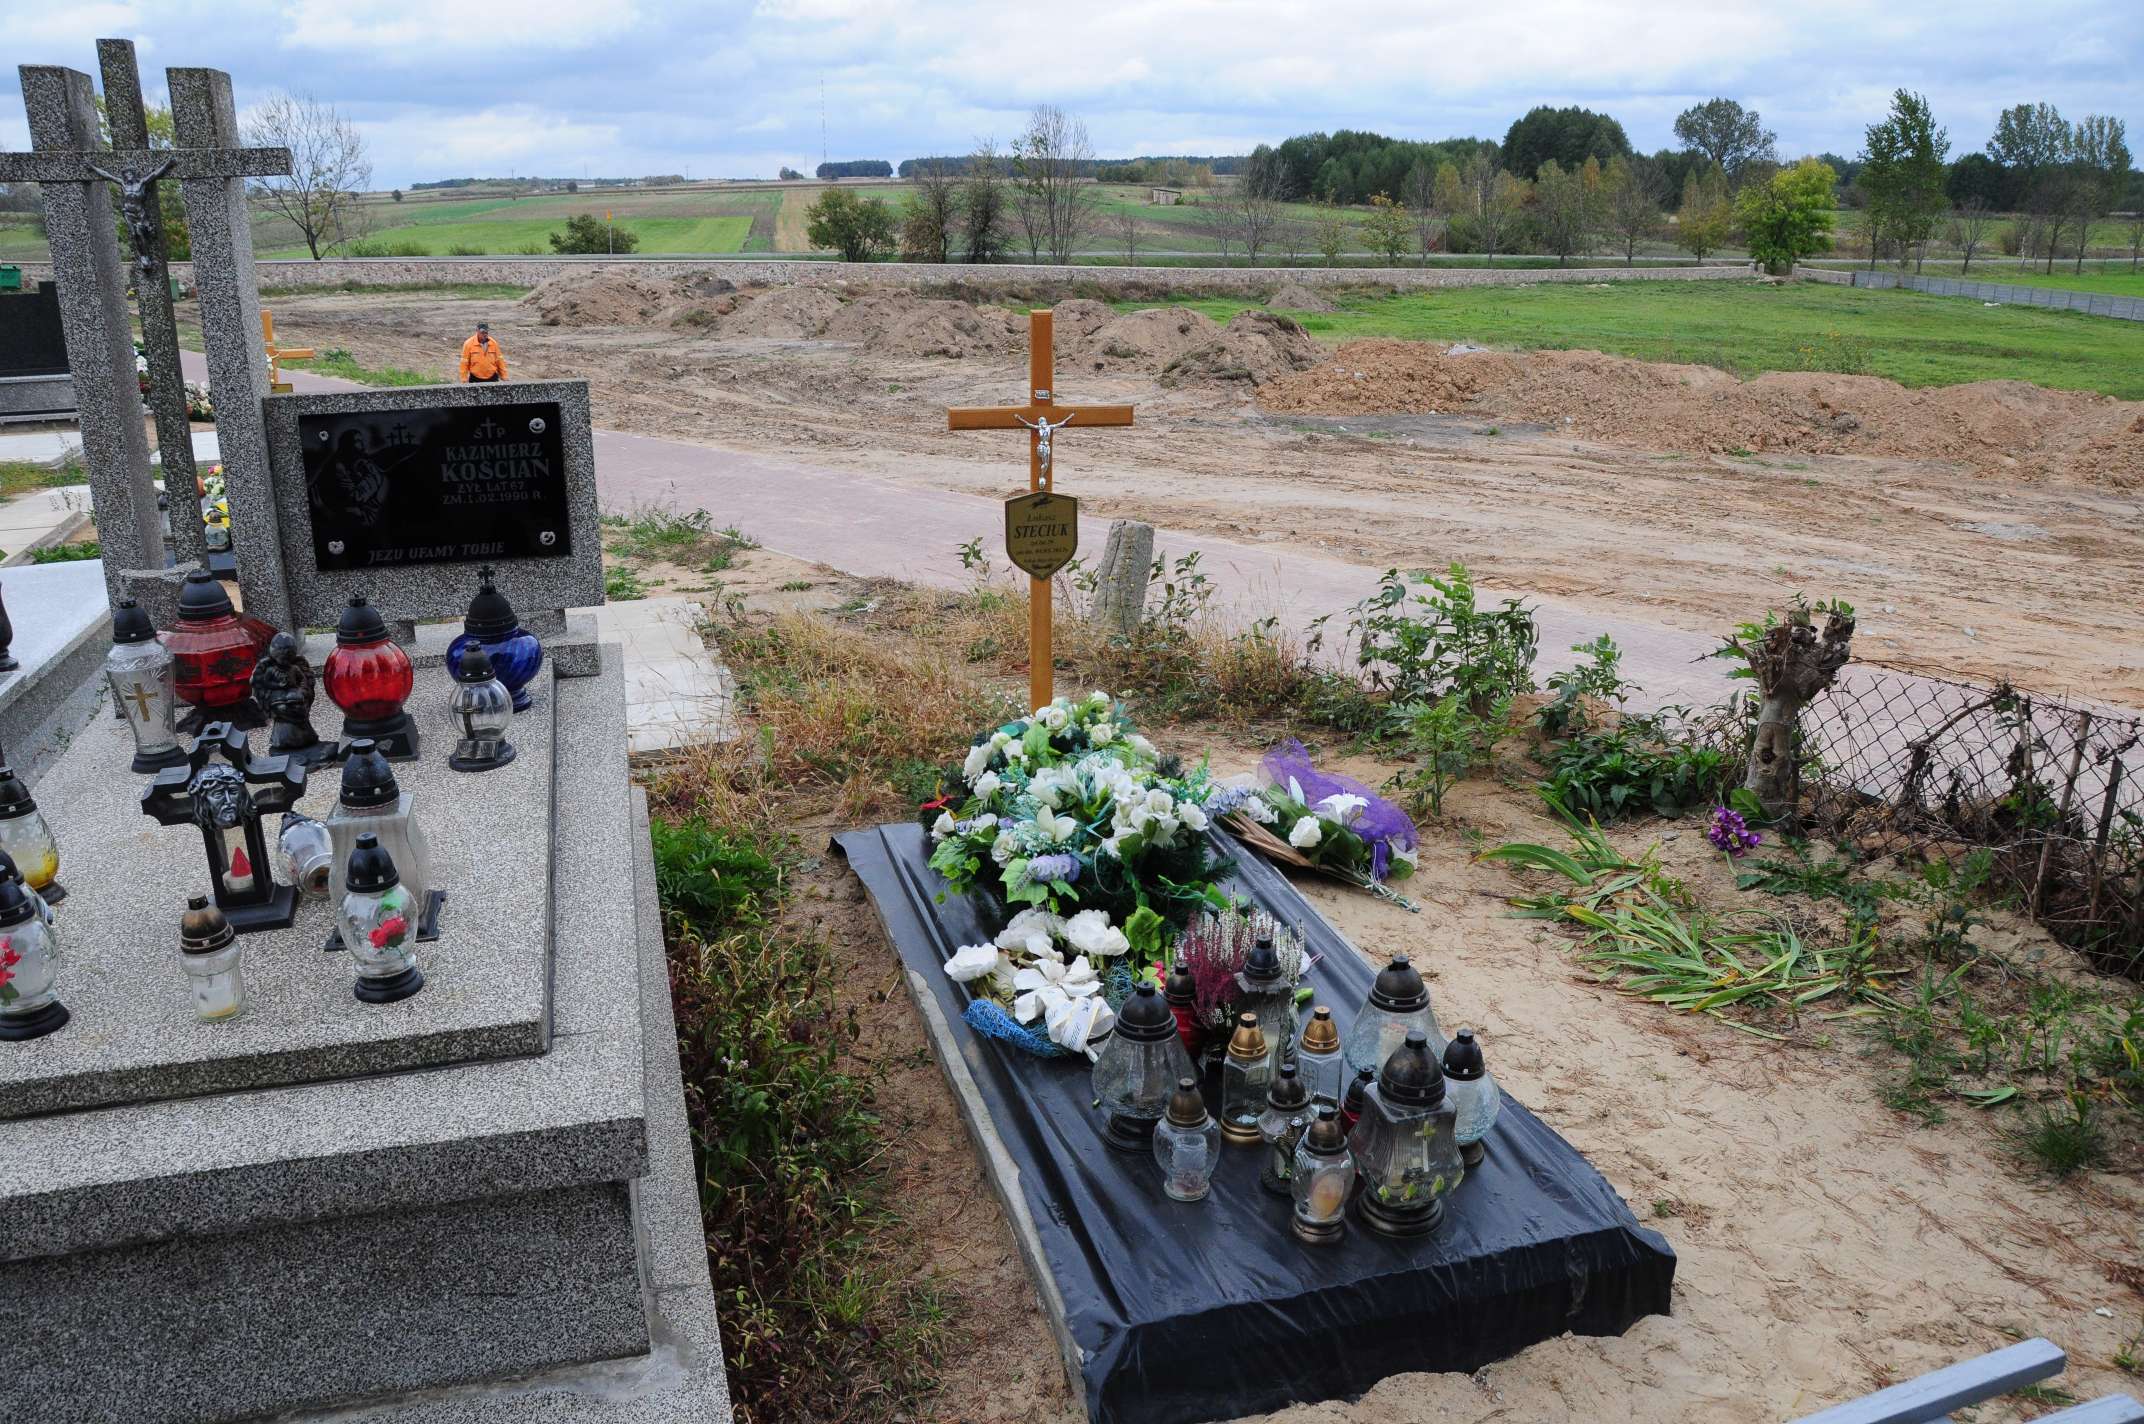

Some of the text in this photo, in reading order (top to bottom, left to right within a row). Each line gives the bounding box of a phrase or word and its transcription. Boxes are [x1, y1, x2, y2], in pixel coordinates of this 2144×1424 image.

[446, 442, 542, 461] KAZIMIERZ
[1014, 523, 1068, 538] STECIUK
[368, 541, 505, 564] JEZU UFAMY TOBIE
